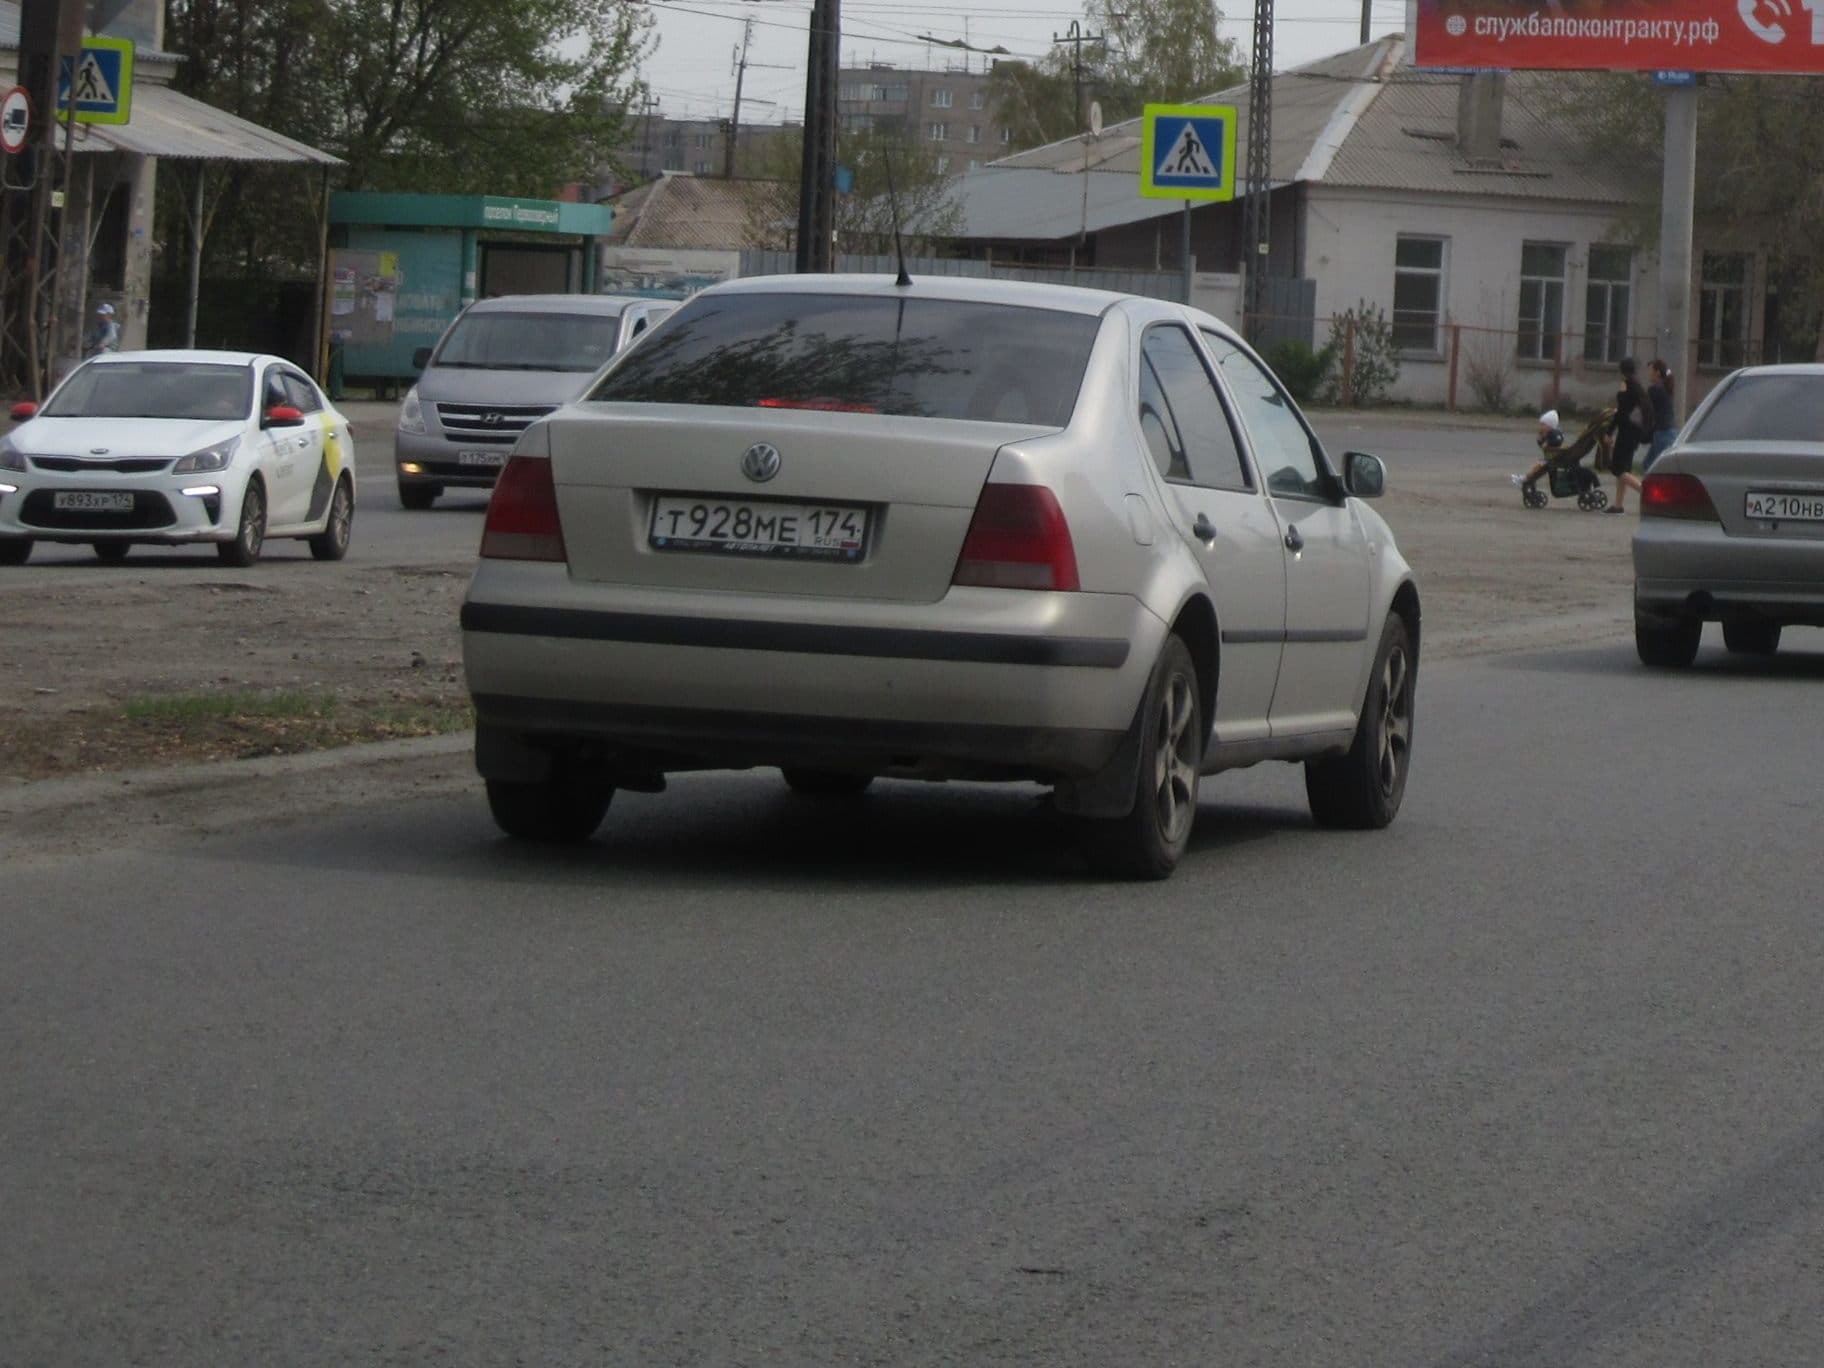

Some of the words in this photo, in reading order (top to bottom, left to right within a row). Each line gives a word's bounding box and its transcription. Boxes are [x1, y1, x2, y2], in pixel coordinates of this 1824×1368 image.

[1474, 11, 1720, 45] службапоконтракту.рф
[668, 504, 798, 543] Т928МЕ
[807, 509, 856, 537] 174
[1753, 497, 1824, 517] А210НВ
